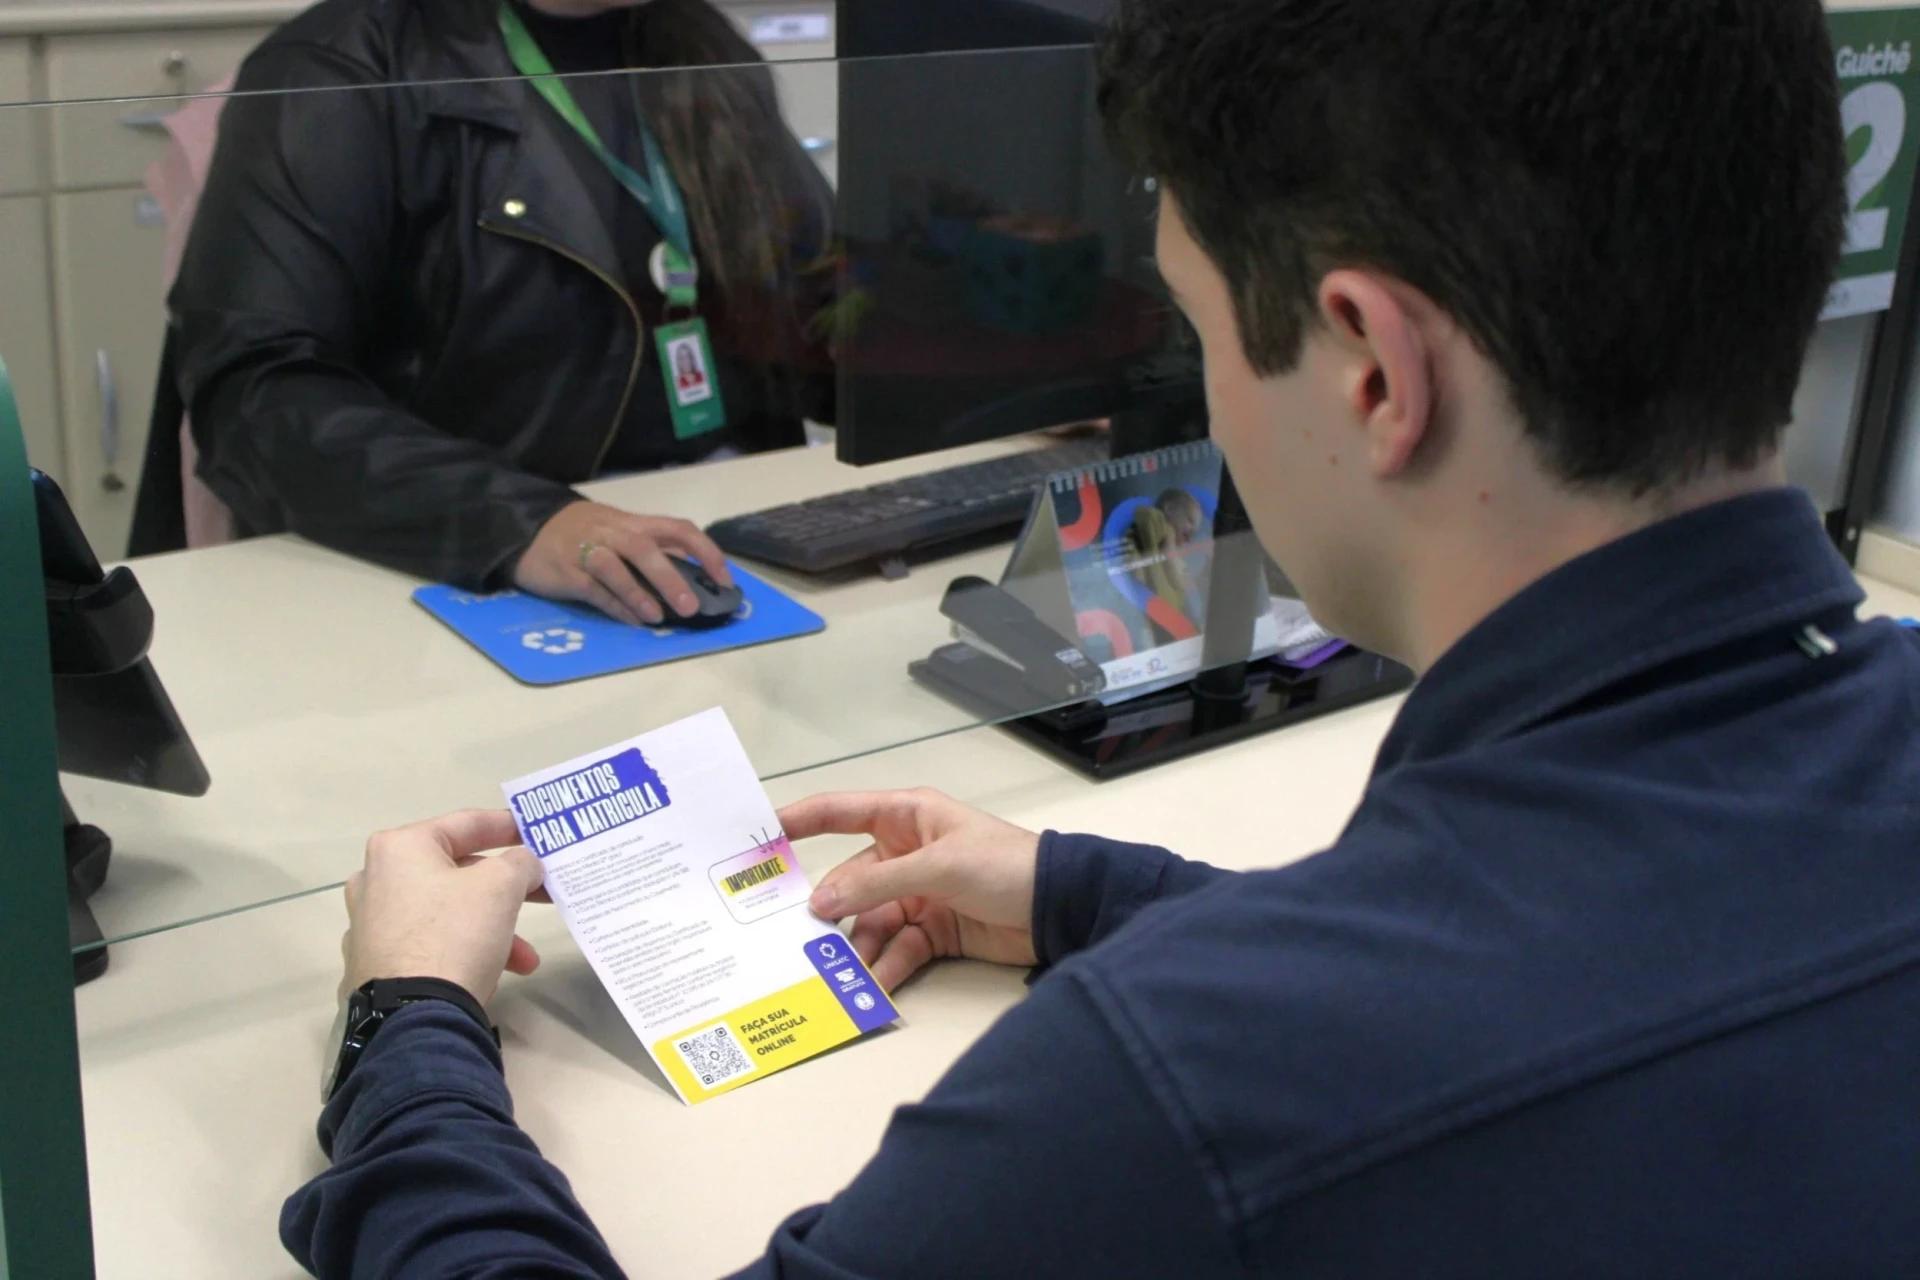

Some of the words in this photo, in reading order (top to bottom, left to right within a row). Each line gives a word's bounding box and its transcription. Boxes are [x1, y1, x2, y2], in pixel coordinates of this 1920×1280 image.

[1836, 41, 1911, 78] Guichê
[1839, 81, 1906, 255] 2
[516, 762, 621, 823] DOCUMENTOS
[529, 815, 578, 855] PARA
[725, 857, 785, 893] IMPORTANTE
[740, 1018, 768, 1033] FAÇA
[767, 1008, 790, 1022] SUA
[748, 1015, 808, 1044] MATRÍCULA
[756, 1034, 797, 1055] ONLINE
